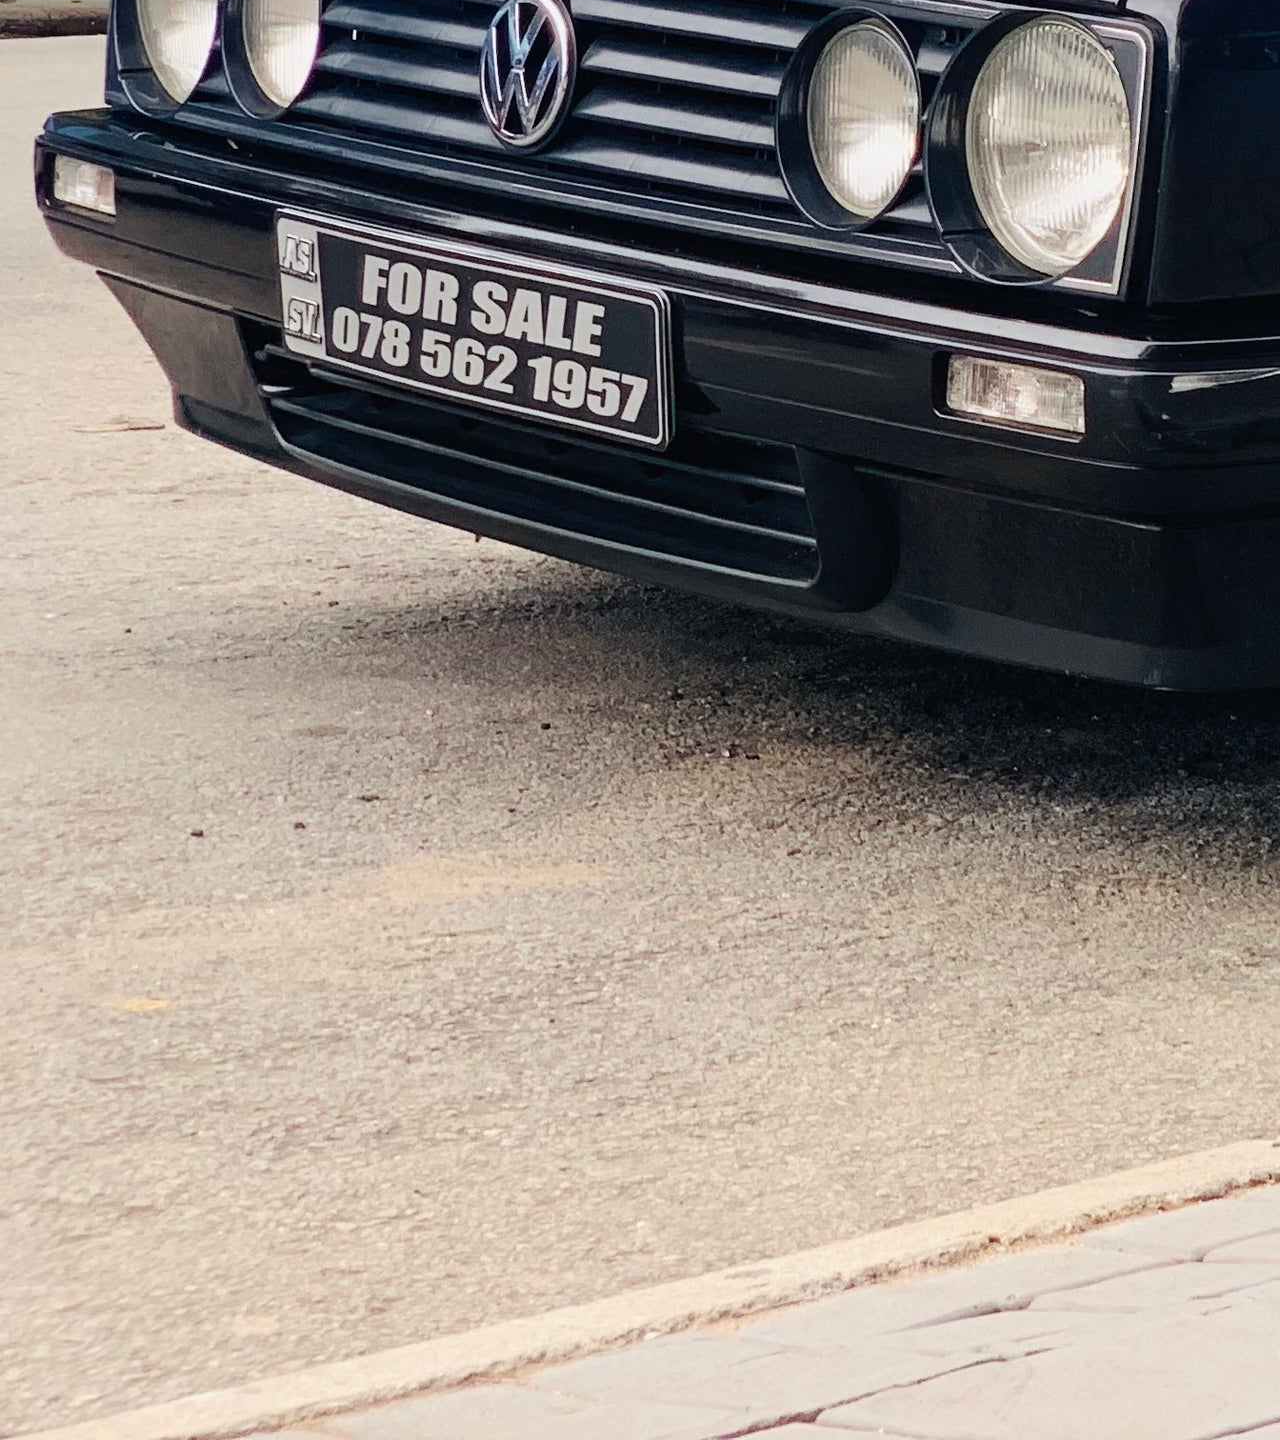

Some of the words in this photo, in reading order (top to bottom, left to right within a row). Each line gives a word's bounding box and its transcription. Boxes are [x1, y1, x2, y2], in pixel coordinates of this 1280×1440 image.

[361, 254, 460, 326] FOR
[470, 280, 606, 357] SALE
[332, 307, 410, 367] 078
[420, 329, 518, 394] 562
[528, 355, 649, 423] 1957
